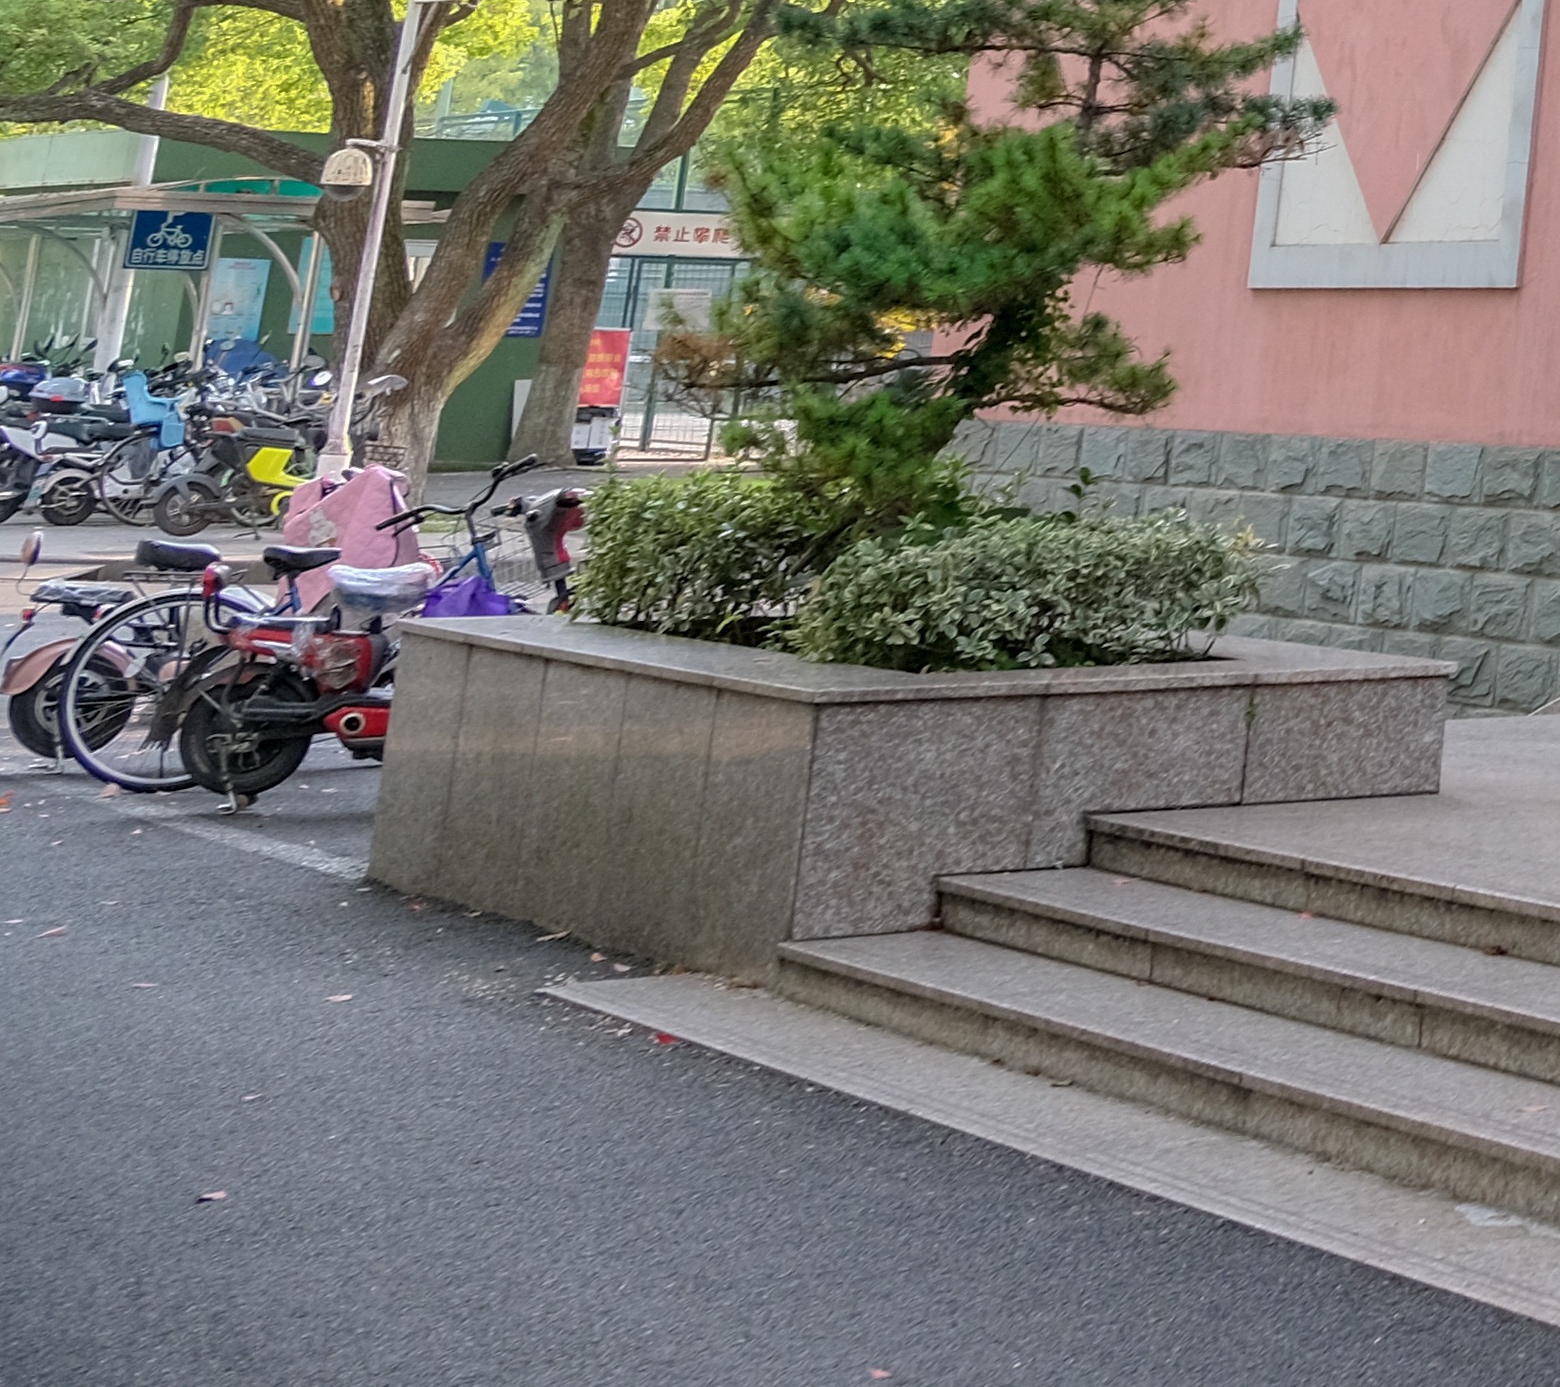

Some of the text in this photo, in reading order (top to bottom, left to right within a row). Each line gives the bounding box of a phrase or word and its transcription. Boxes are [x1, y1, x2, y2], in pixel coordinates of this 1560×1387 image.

[131, 247, 205, 265] 自行车停放点
